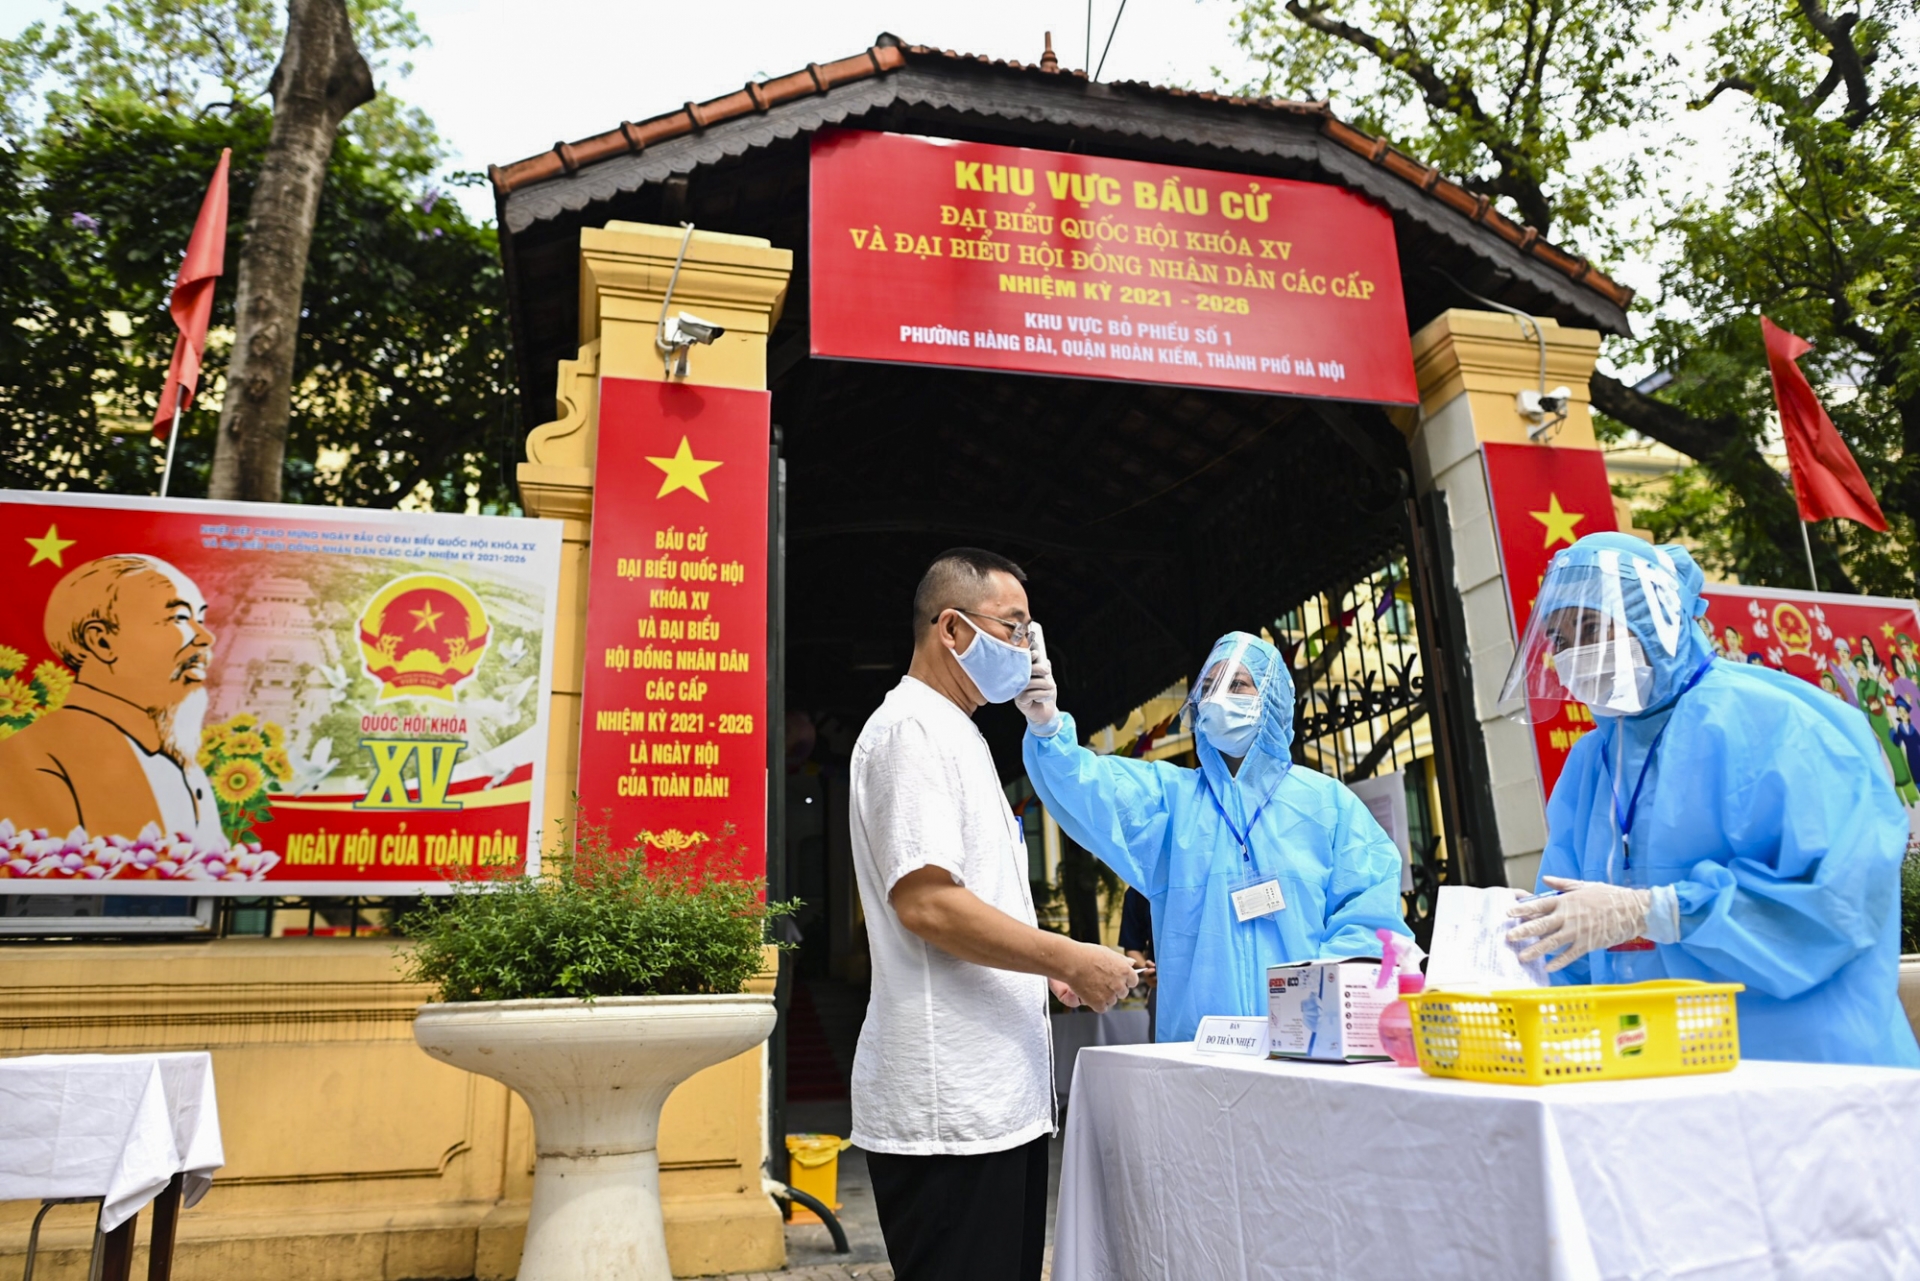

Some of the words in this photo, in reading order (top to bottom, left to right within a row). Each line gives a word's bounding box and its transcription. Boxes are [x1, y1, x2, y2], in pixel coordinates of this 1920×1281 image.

[955, 160, 1035, 196] KHU
[1046, 171, 1121, 208] VỰC
[1133, 175, 1209, 216] BẦU
[1219, 182, 1272, 223] CỬ
[940, 205, 987, 232] ĐẠI
[994, 201, 1053, 235] BIỂU
[1060, 214, 1129, 244] QUỐC
[1135, 222, 1179, 252] HỘI
[1184, 230, 1253, 257] KHÓA
[1259, 239, 1292, 261] XV
[849, 224, 888, 251] VÀ
[894, 232, 943, 260] ĐẠI
[949, 228, 1010, 263] BIỂU
[1018, 241, 1065, 272] HỘI
[1071, 243, 1143, 276] ĐỒNG
[1148, 256, 1219, 284] NHÂN
[1225, 262, 1275, 290] DÂN
[1281, 268, 1327, 296] CÁC
[1331, 271, 1375, 300] CẤP
[999, 274, 1077, 300] NHIỆM
[1083, 280, 1113, 302] KỲ
[1119, 285, 1172, 308] 2021
[1196, 293, 1250, 315] 2026
[1024, 312, 1063, 331] KHU
[1067, 316, 1103, 337] VỰC
[1108, 315, 1132, 336] BỎ
[1137, 321, 1190, 342] PHIẾU
[1195, 324, 1218, 345] SỐ
[1223, 331, 1232, 346] 1
[900, 324, 970, 347] PHƯỜNG
[974, 329, 1020, 351] HÀNG
[1024, 334, 1058, 356] BÀI,
[1061, 338, 1106, 360] QUẬN
[1110, 343, 1154, 363] HOÀN
[1158, 345, 1202, 369] KIẾM,
[1206, 352, 1257, 372] THÀNH
[1261, 354, 1291, 375] PHỐ
[1294, 358, 1316, 377] HÀ
[1319, 360, 1345, 383] NỘI
[394, 535, 411, 546] ĐẠI
[437, 535, 467, 548] QUỐC
[470, 538, 488, 550] HỘI
[491, 539, 518, 550] KHÓA
[521, 542, 536, 551] XV
[687, 526, 709, 552] CỬ
[379, 547, 401, 557] CÁC
[404, 547, 426, 558] CẤP
[428, 551, 459, 561] NHIỆM
[462, 550, 475, 561] KỲ
[478, 553, 526, 563] 2021-2026
[617, 558, 641, 582] ĐẠI
[645, 553, 677, 579] BIỂU
[680, 556, 717, 582] QUỐC
[721, 560, 744, 587] HỘI
[650, 586, 687, 609] KHÓA
[691, 591, 710, 610] XV
[638, 615, 656, 639] VÀ
[660, 619, 684, 644] ĐẠI
[687, 614, 720, 641] BIỂU
[605, 644, 629, 673] HỘI
[676, 647, 716, 671] NHÂN
[719, 649, 749, 672] DÂN
[645, 676, 675, 701] CÁC
[678, 675, 708, 701] CẤP
[362, 711, 398, 732] QUỐC
[403, 714, 426, 736] HỘI
[431, 714, 467, 733] KHÓA
[596, 707, 644, 736] NHIỆM
[648, 708, 667, 732] KỲ
[670, 713, 704, 733] 2021
[718, 714, 753, 734] 2026
[630, 739, 648, 764] LÀ
[652, 739, 691, 765] NGÀY
[694, 740, 719, 769] HỘI
[1549, 726, 1570, 753] HỘI
[353, 738, 469, 811] XV
[617, 767, 648, 797] CỦA
[651, 772, 690, 797] TOÀN
[693, 772, 729, 797] DÂN!
[285, 827, 340, 865] NGÀY
[342, 828, 377, 873] HỘI
[380, 821, 419, 866] CỦA
[424, 828, 474, 866] TOÀN
[477, 829, 518, 866] DÂN
